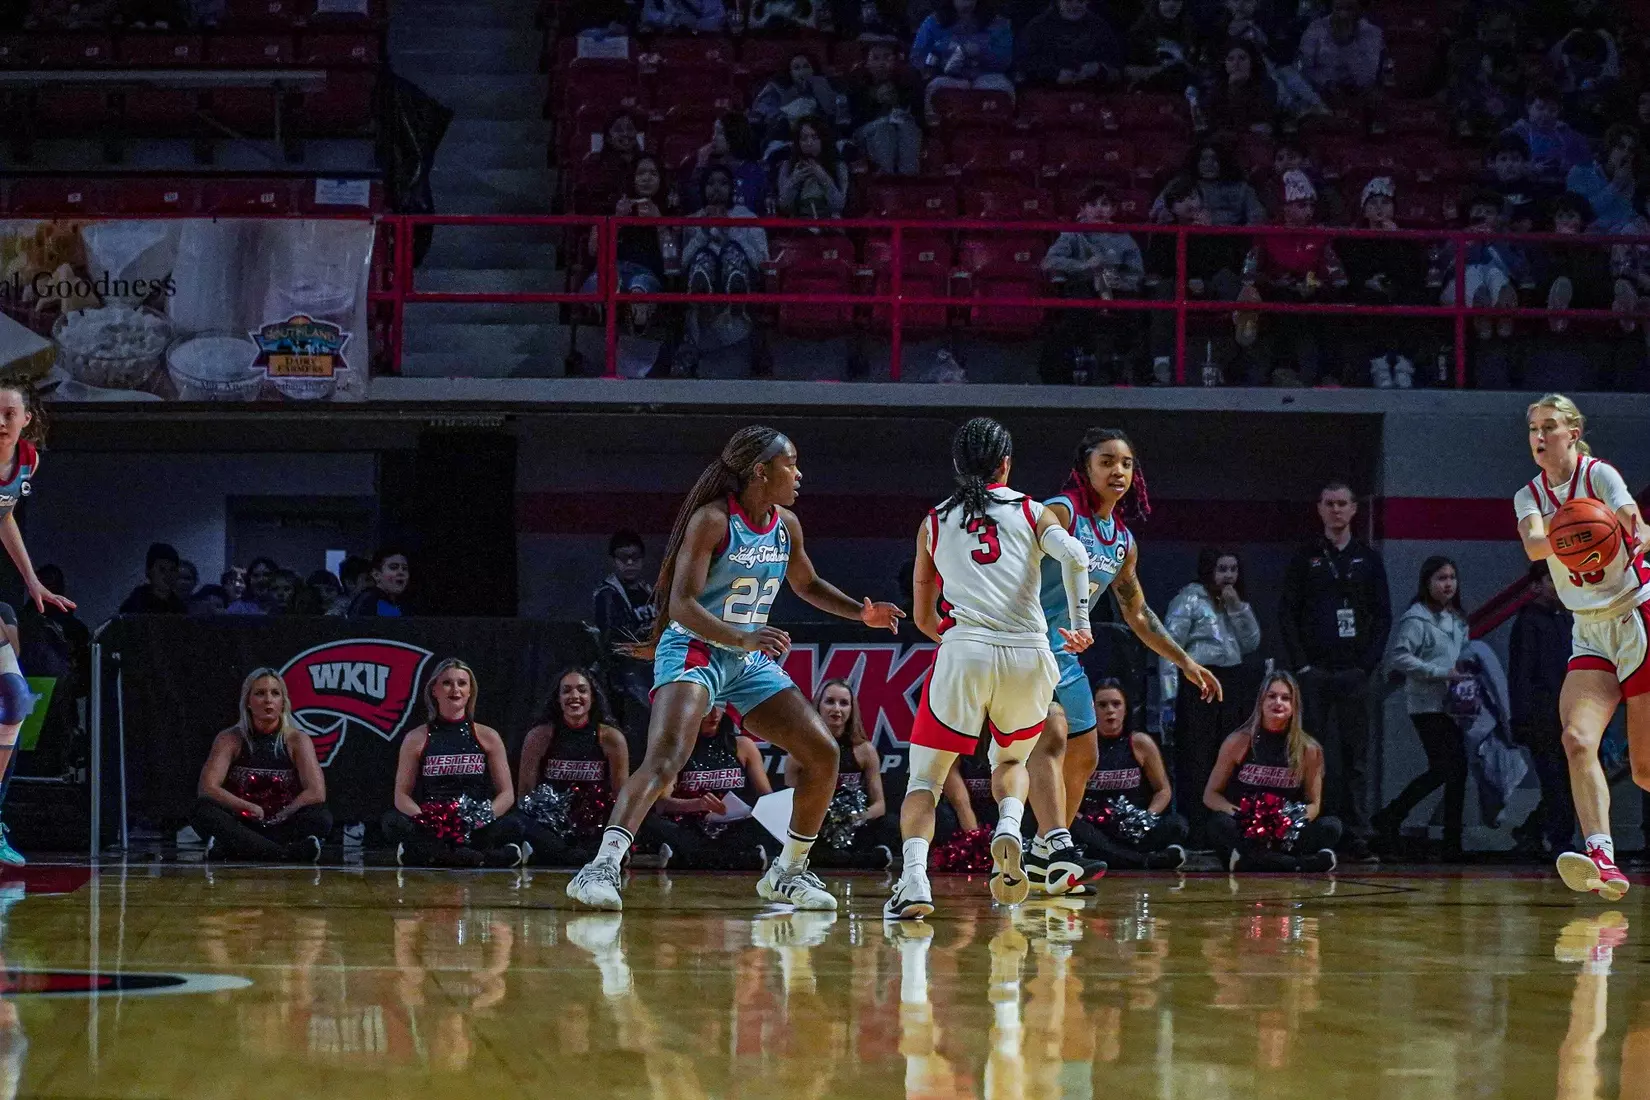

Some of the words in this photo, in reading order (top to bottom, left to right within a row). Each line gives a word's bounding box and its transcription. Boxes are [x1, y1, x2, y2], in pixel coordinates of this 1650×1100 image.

[32, 271, 177, 297] Goodness
[967, 517, 1001, 565] 3
[1556, 530, 1593, 549] ELITE
[728, 545, 757, 569] Lady
[722, 577, 781, 624] 22
[308, 661, 391, 702] WKU
[422, 764, 486, 777] KENTUCK
[425, 754, 486, 766] WESTERN
[545, 769, 604, 781] KENTUCK
